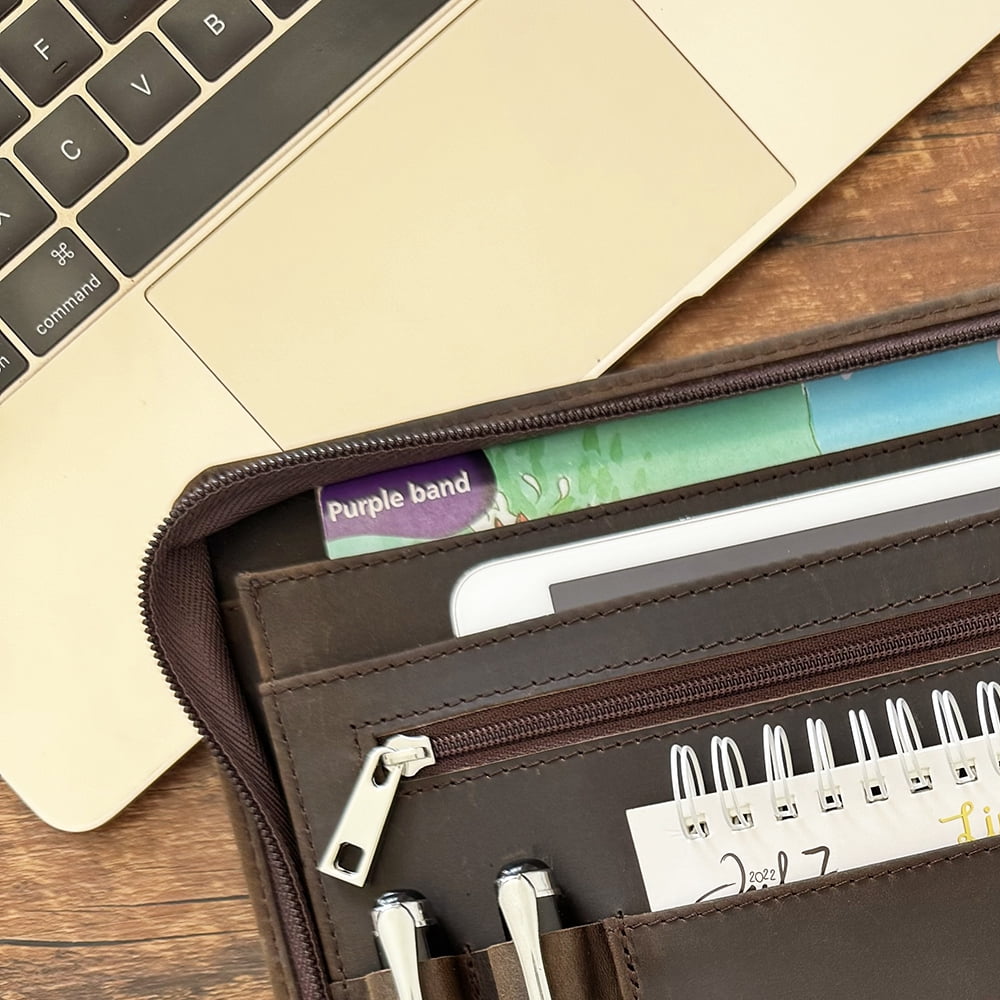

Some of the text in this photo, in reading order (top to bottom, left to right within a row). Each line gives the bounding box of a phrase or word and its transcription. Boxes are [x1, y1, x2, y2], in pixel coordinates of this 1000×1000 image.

[203, 13, 226, 36] B
[33, 38, 50, 61] F
[130, 74, 151, 95] V
[60, 139, 81, 161] C
[37, 273, 101, 335] command
[328, 470, 471, 522] Purple band
[749, 868, 776, 884] 2022
